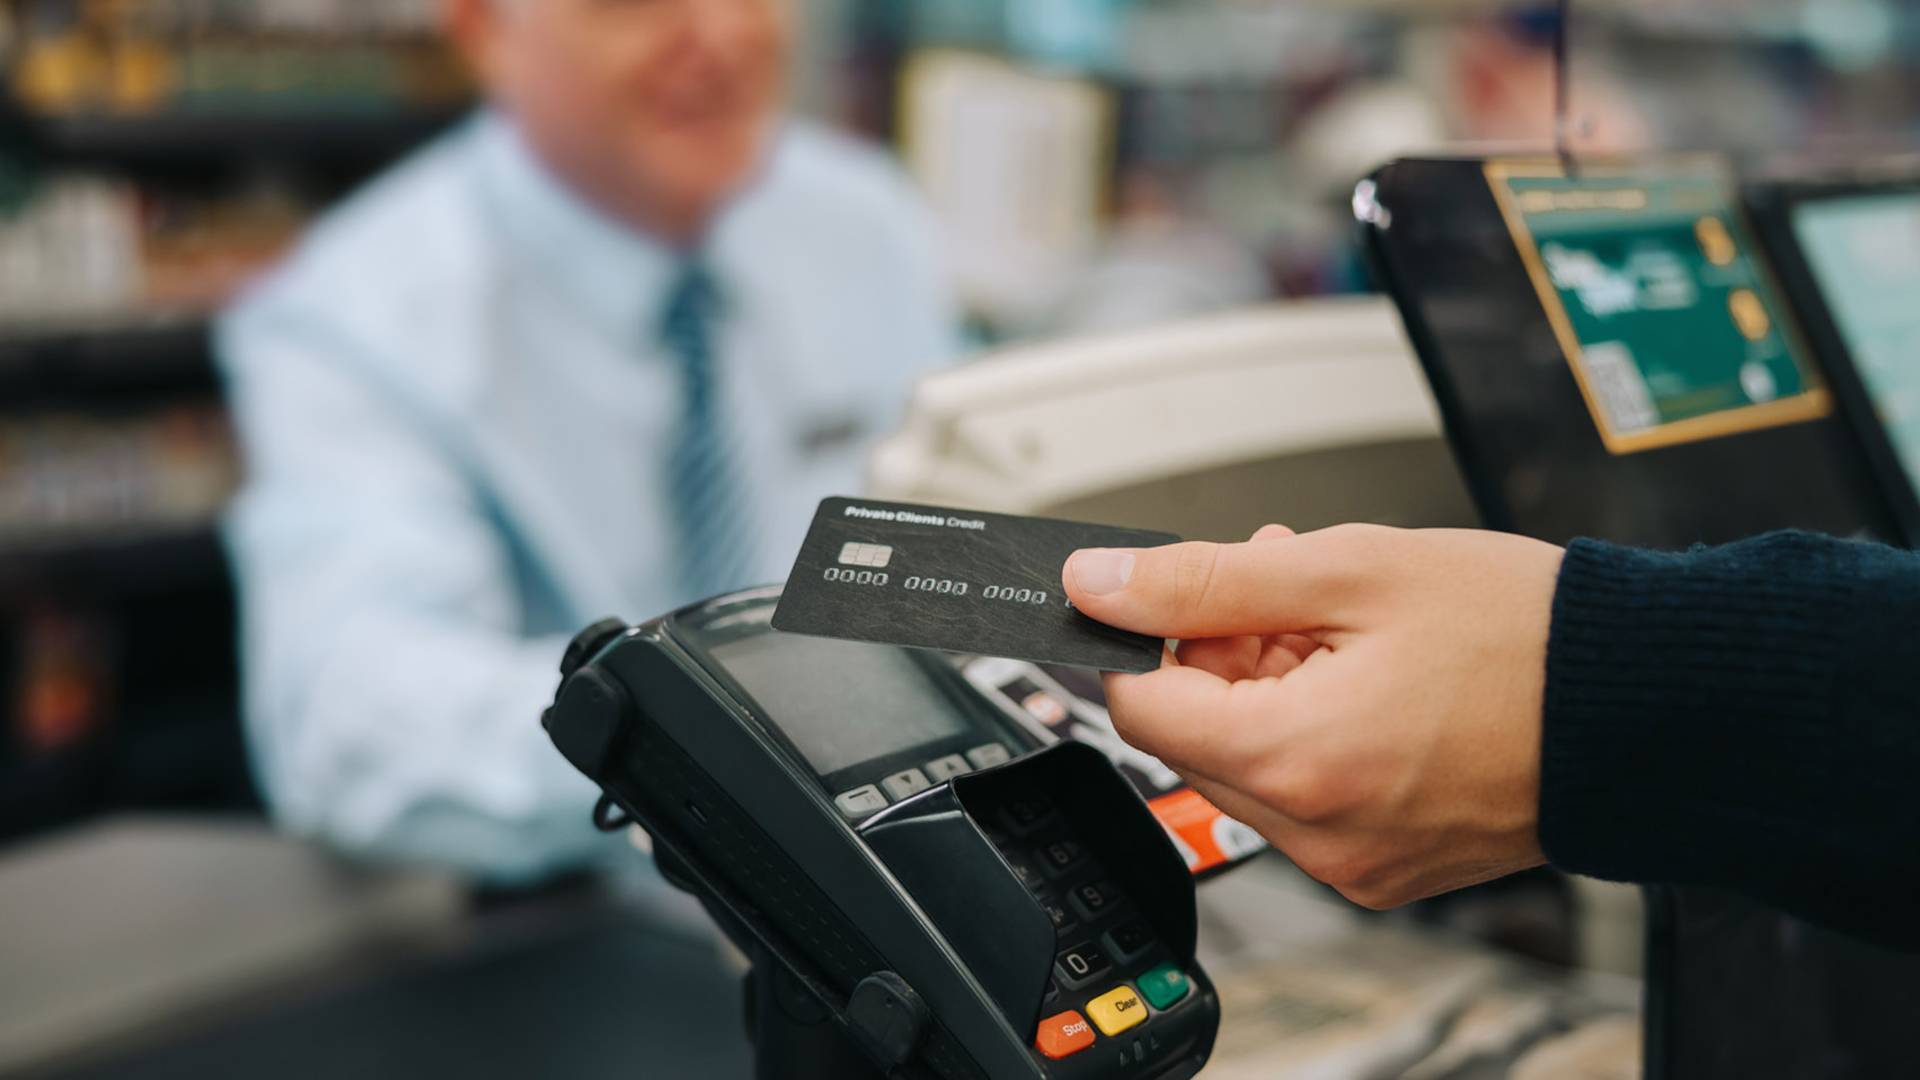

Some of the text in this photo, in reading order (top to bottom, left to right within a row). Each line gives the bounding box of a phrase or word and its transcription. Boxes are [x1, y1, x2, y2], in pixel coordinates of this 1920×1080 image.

[844, 506, 986, 531] Private Clients Credit
[823, 567, 889, 587] 0000
[904, 576, 968, 596] 0000
[983, 585, 1047, 605] 0000
[1082, 885, 1105, 907] 9
[1066, 953, 1089, 974] 0
[1115, 997, 1137, 1013] Clear
[1062, 1020, 1089, 1037] Stop
